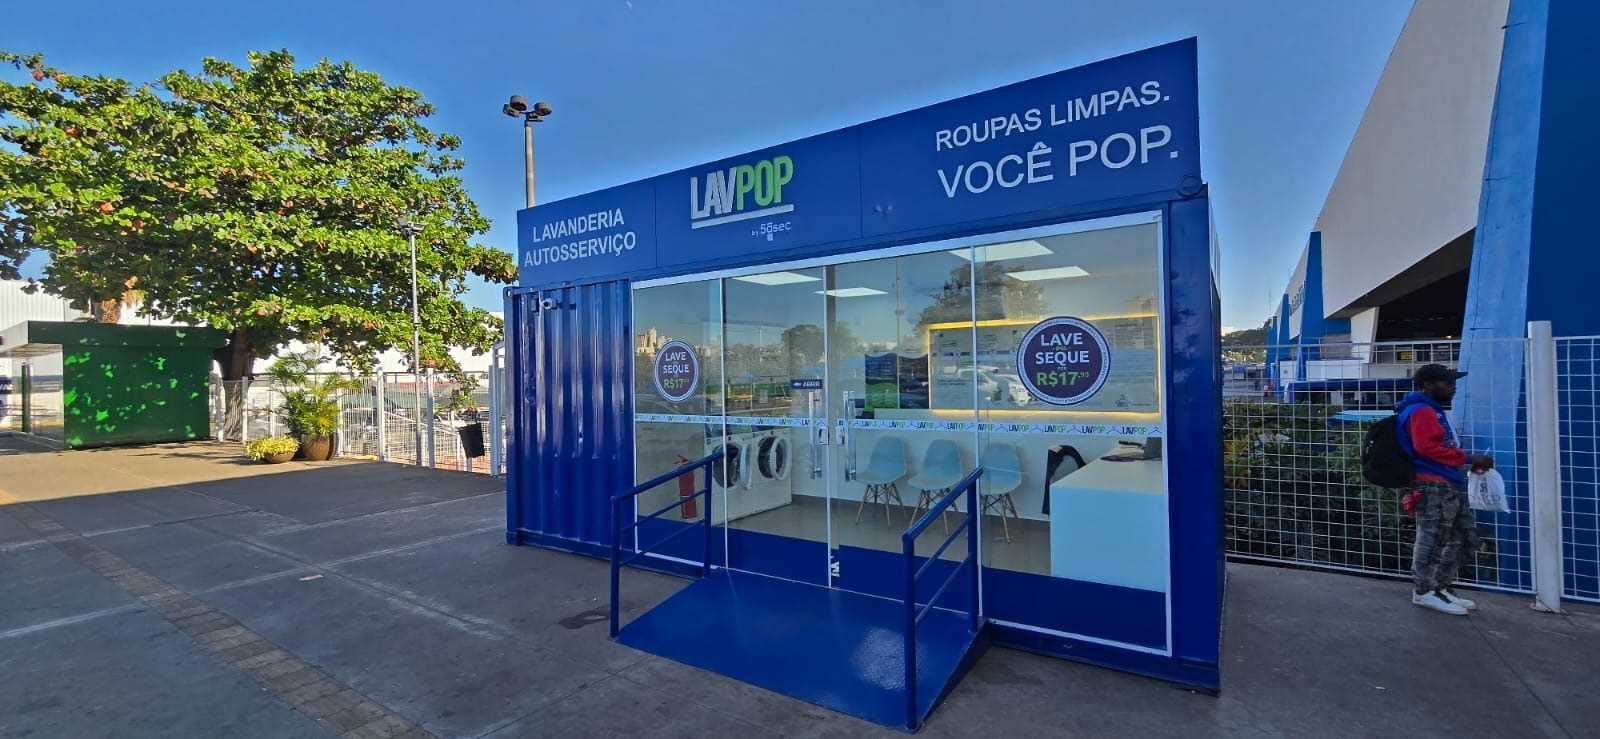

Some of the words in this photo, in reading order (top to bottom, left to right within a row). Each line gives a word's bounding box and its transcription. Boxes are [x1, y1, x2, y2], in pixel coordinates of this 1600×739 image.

[936, 108, 1042, 151] ROUPAS
[1050, 80, 1170, 127] LIMPAS.
[937, 141, 1054, 198] VOCÊ
[1069, 124, 1178, 177] POP.
[690, 155, 794, 220] LAVPOP
[533, 207, 625, 243] LAVANDERIA
[524, 231, 637, 268] AUTOSSERVIÇO
[665, 351, 687, 361] LAVE
[1035, 350, 1090, 366] SEQUE
[1040, 333, 1083, 347] LAVE
[663, 364, 690, 374] SEQUE
